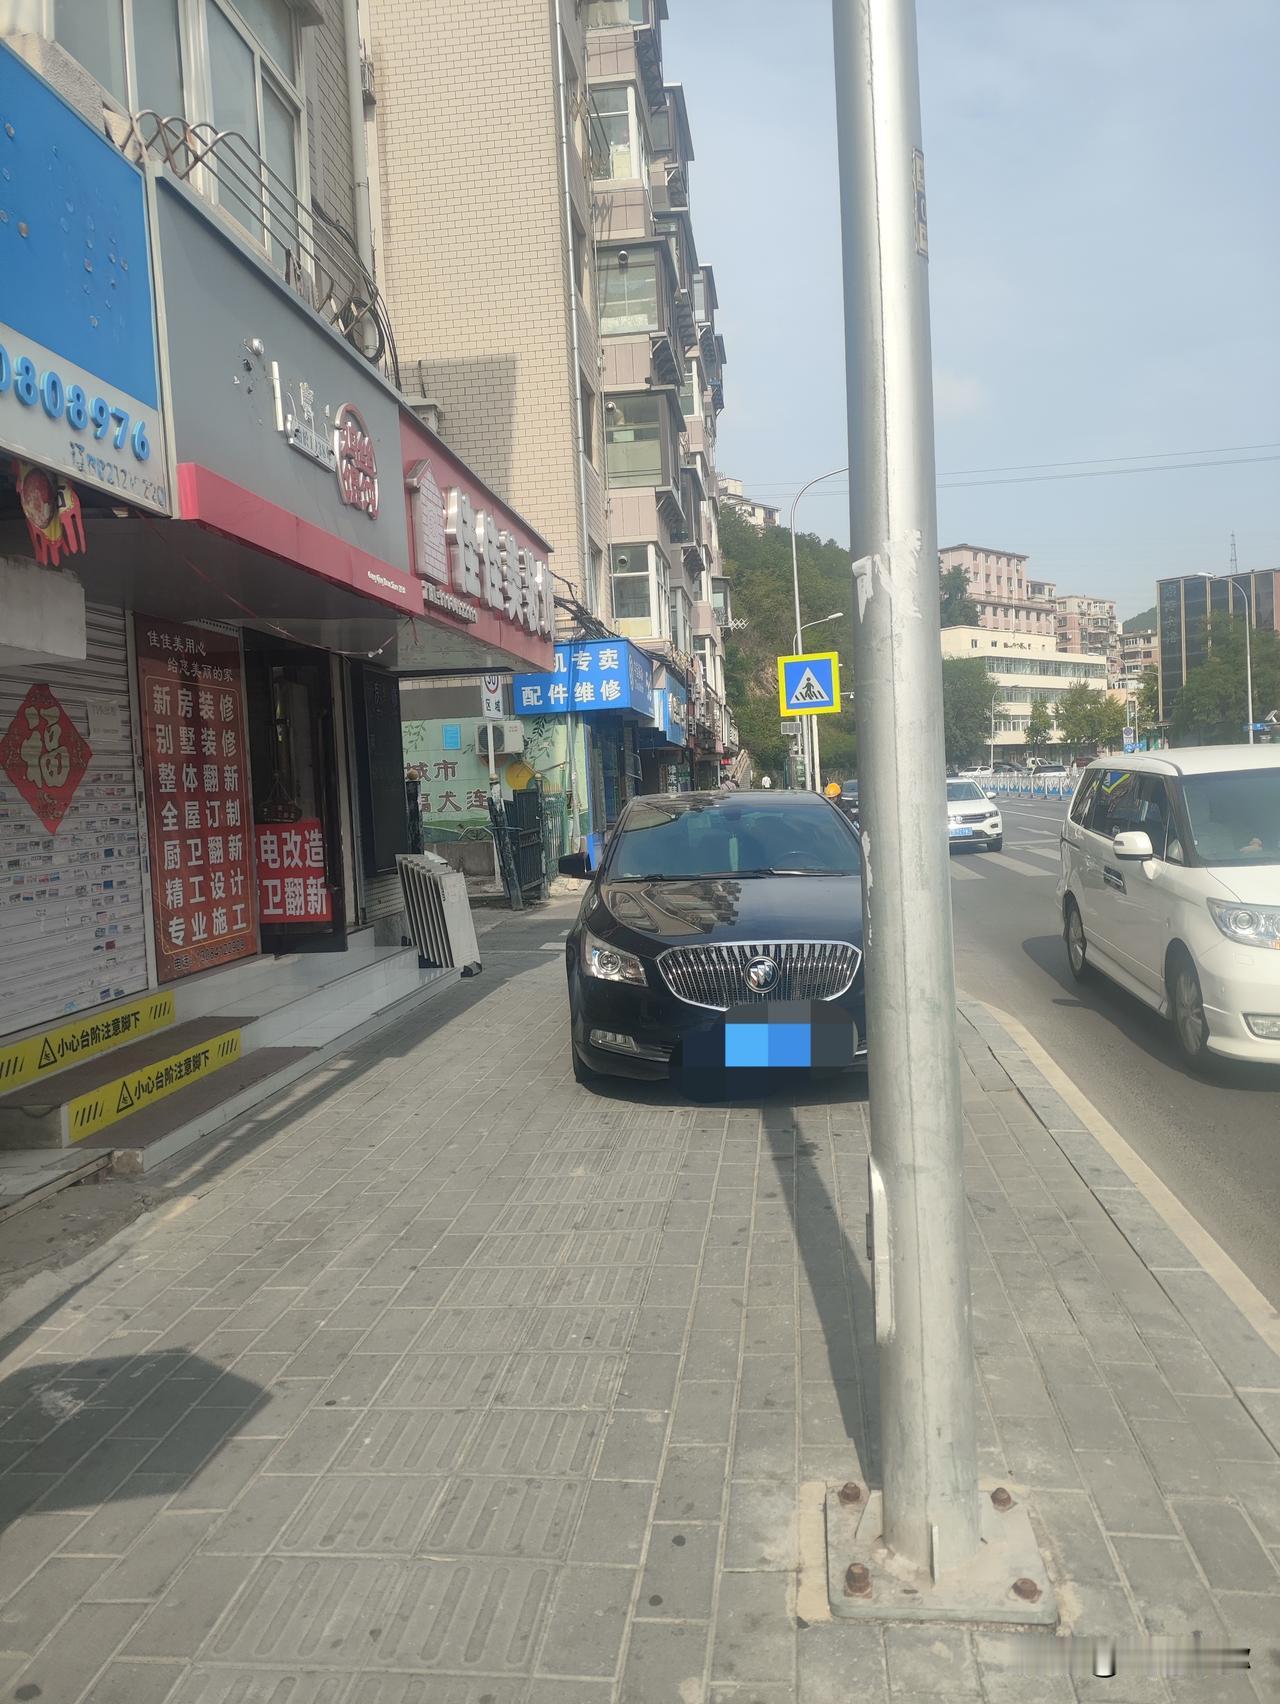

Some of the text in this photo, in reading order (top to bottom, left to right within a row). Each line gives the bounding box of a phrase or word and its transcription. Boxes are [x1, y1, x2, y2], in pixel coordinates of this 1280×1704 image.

[147, 630, 207, 657] 佳佳美用心
[527, 648, 620, 675] 机专卖
[167, 657, 234, 682] 给您美丽的家
[152, 684, 235, 723] 新房装修
[521, 679, 622, 706] 配件维修
[156, 723, 237, 757] 别墅装修
[158, 763, 239, 793] 整体翻新
[161, 799, 241, 832] 全屋订制
[163, 834, 243, 871] 厨卫翻新
[255, 829, 325, 869] 电改造
[165, 870, 245, 910] 精工设计
[256, 876, 327, 916] 卫翻新
[168, 903, 247, 947] 专业施工
[57, 1010, 141, 1059] 小心台阶注意脚下
[134, 1050, 210, 1100] 小心台阶注意脚下
